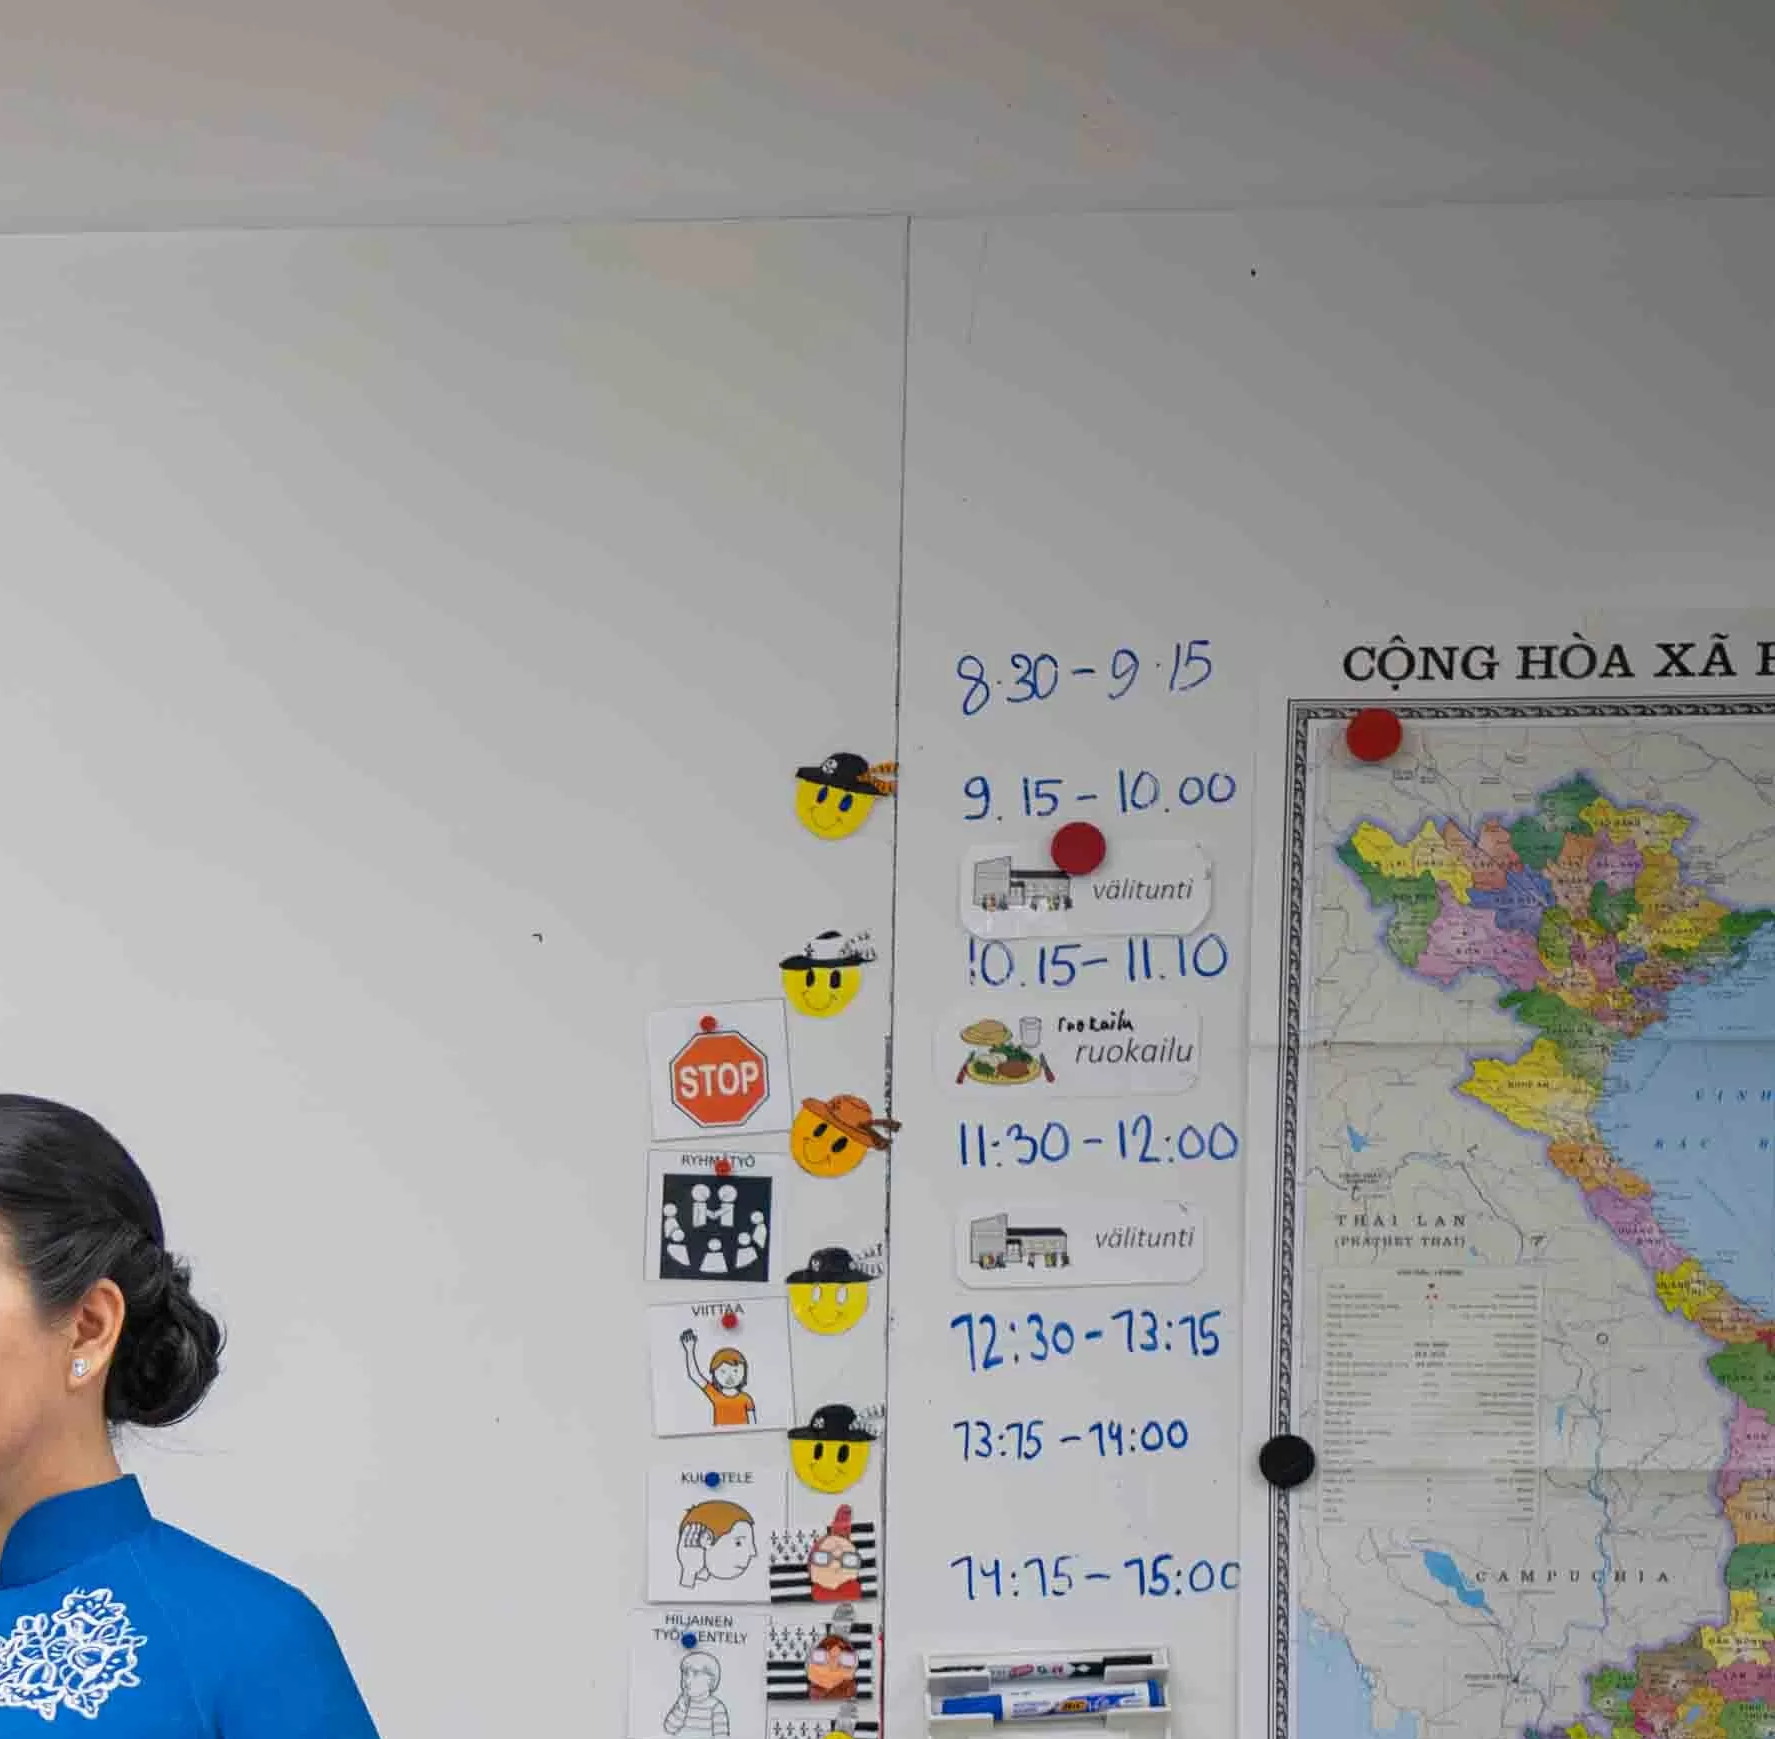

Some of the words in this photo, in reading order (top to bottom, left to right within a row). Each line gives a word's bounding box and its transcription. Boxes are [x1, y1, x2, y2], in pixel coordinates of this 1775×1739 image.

[1342, 633, 1500, 691] CỘNG
[1516, 631, 1636, 681] HÒA
[1653, 632, 1737, 679] XÃ
[1091, 877, 1196, 901] välitunti
[1075, 1036, 1194, 1064] ruokailu
[679, 1060, 760, 1100] STOP
[1094, 1224, 1197, 1249] välitunti
[1474, 1568, 1671, 1585] CAMPUCHIA
[665, 1614, 734, 1629] HILJAINEN
[653, 1627, 748, 1646] TYÖENTELY
